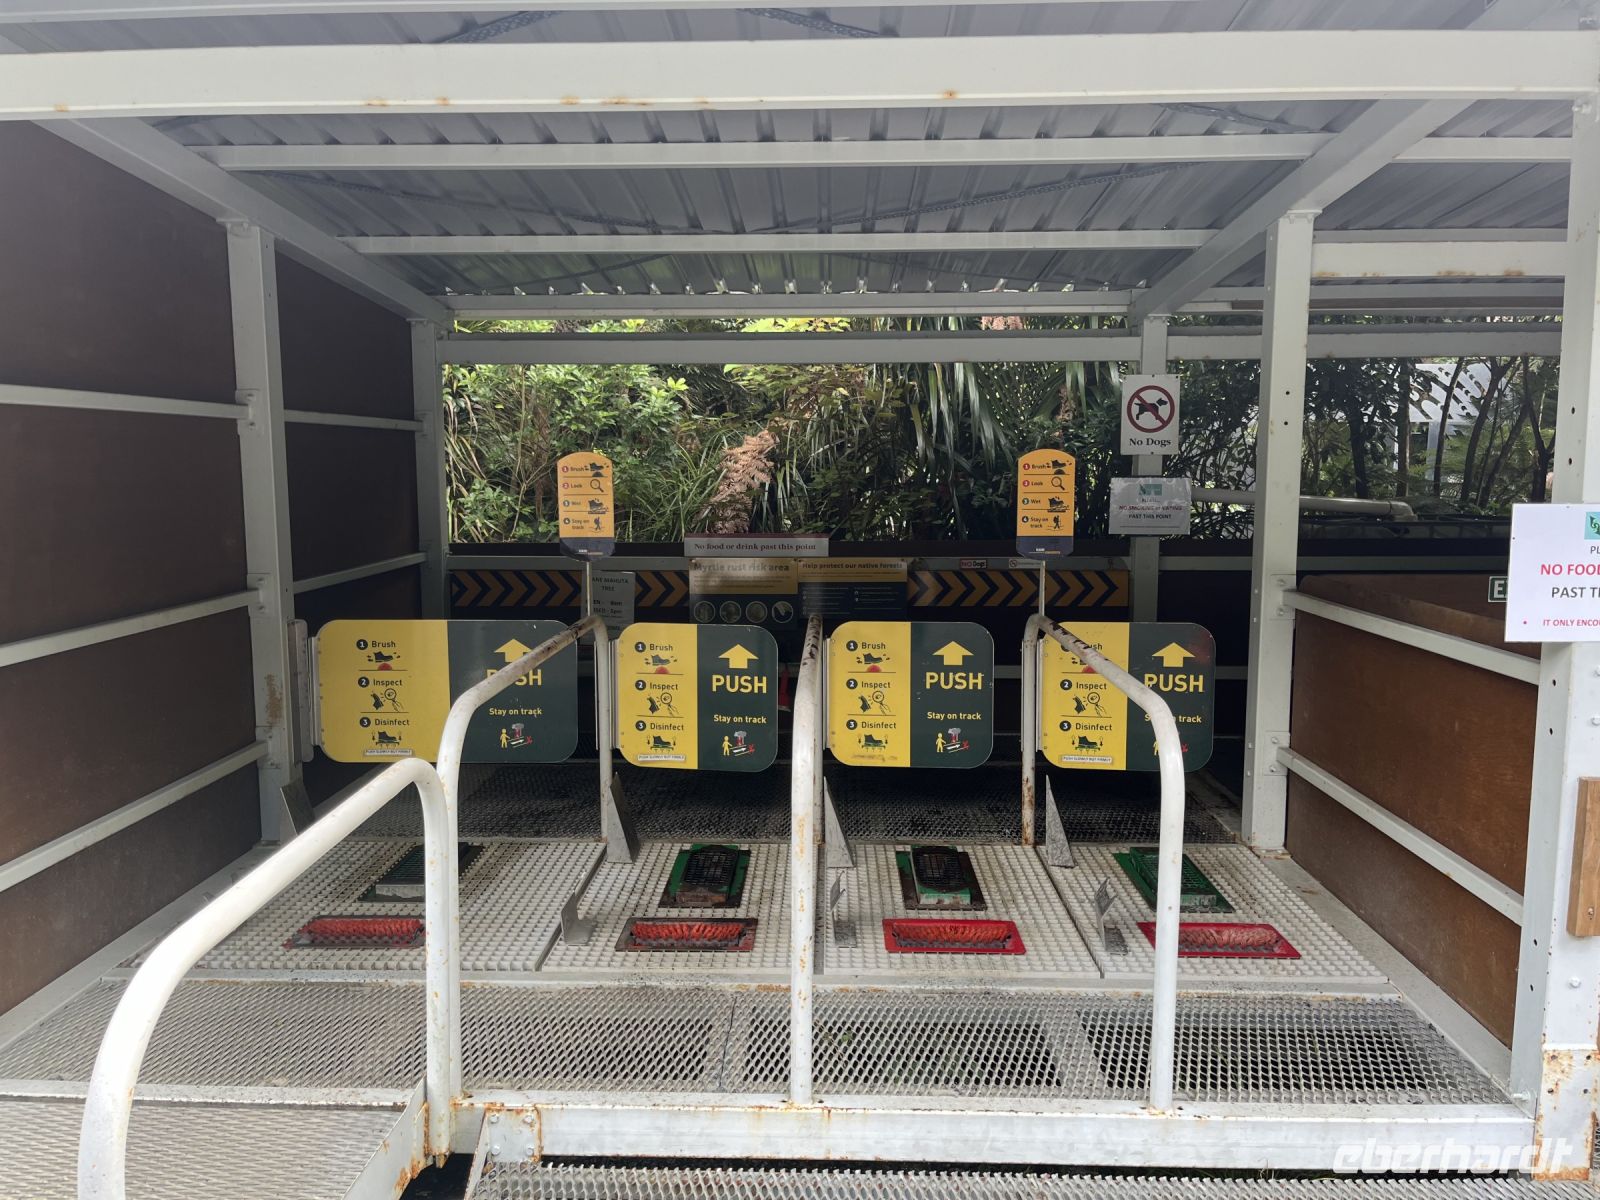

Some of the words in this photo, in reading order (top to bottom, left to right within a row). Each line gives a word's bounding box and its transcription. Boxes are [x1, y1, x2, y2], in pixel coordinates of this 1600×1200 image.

[1129, 438, 1143, 446] No
[1146, 437, 1172, 448] Dogs
[795, 543, 816, 551] point
[693, 563, 725, 572] Myrtle
[727, 563, 747, 571] rust
[748, 563, 767, 571] risk
[1540, 563, 1563, 576] NO
[1567, 563, 1600, 576] FOO
[1493, 580, 1508, 599] E
[1551, 586, 1586, 598] PAST
[1543, 619, 1550, 627] IT
[1552, 619, 1575, 627] ONLY
[371, 640, 396, 648] Brush
[649, 643, 674, 652] Brush
[861, 641, 886, 650] Brush
[372, 678, 403, 688] Inspect
[712, 674, 767, 694] PUSH
[861, 681, 891, 690] Inspect
[925, 671, 983, 690] PUSH
[1144, 673, 1204, 693] PUSH
[650, 682, 679, 692] Inspect
[1076, 681, 1107, 691] Inspect
[489, 706, 507, 717] Stay
[521, 707, 542, 716] track
[927, 711, 945, 721] Stay
[959, 711, 982, 720] track
[374, 717, 410, 727] Disinfect
[713, 714, 731, 724] Stay
[745, 715, 767, 724] track
[1178, 714, 1203, 723] track
[650, 722, 685, 732] Disinfect
[861, 721, 897, 730] Disinfect
[1075, 722, 1112, 732] Disinfect
